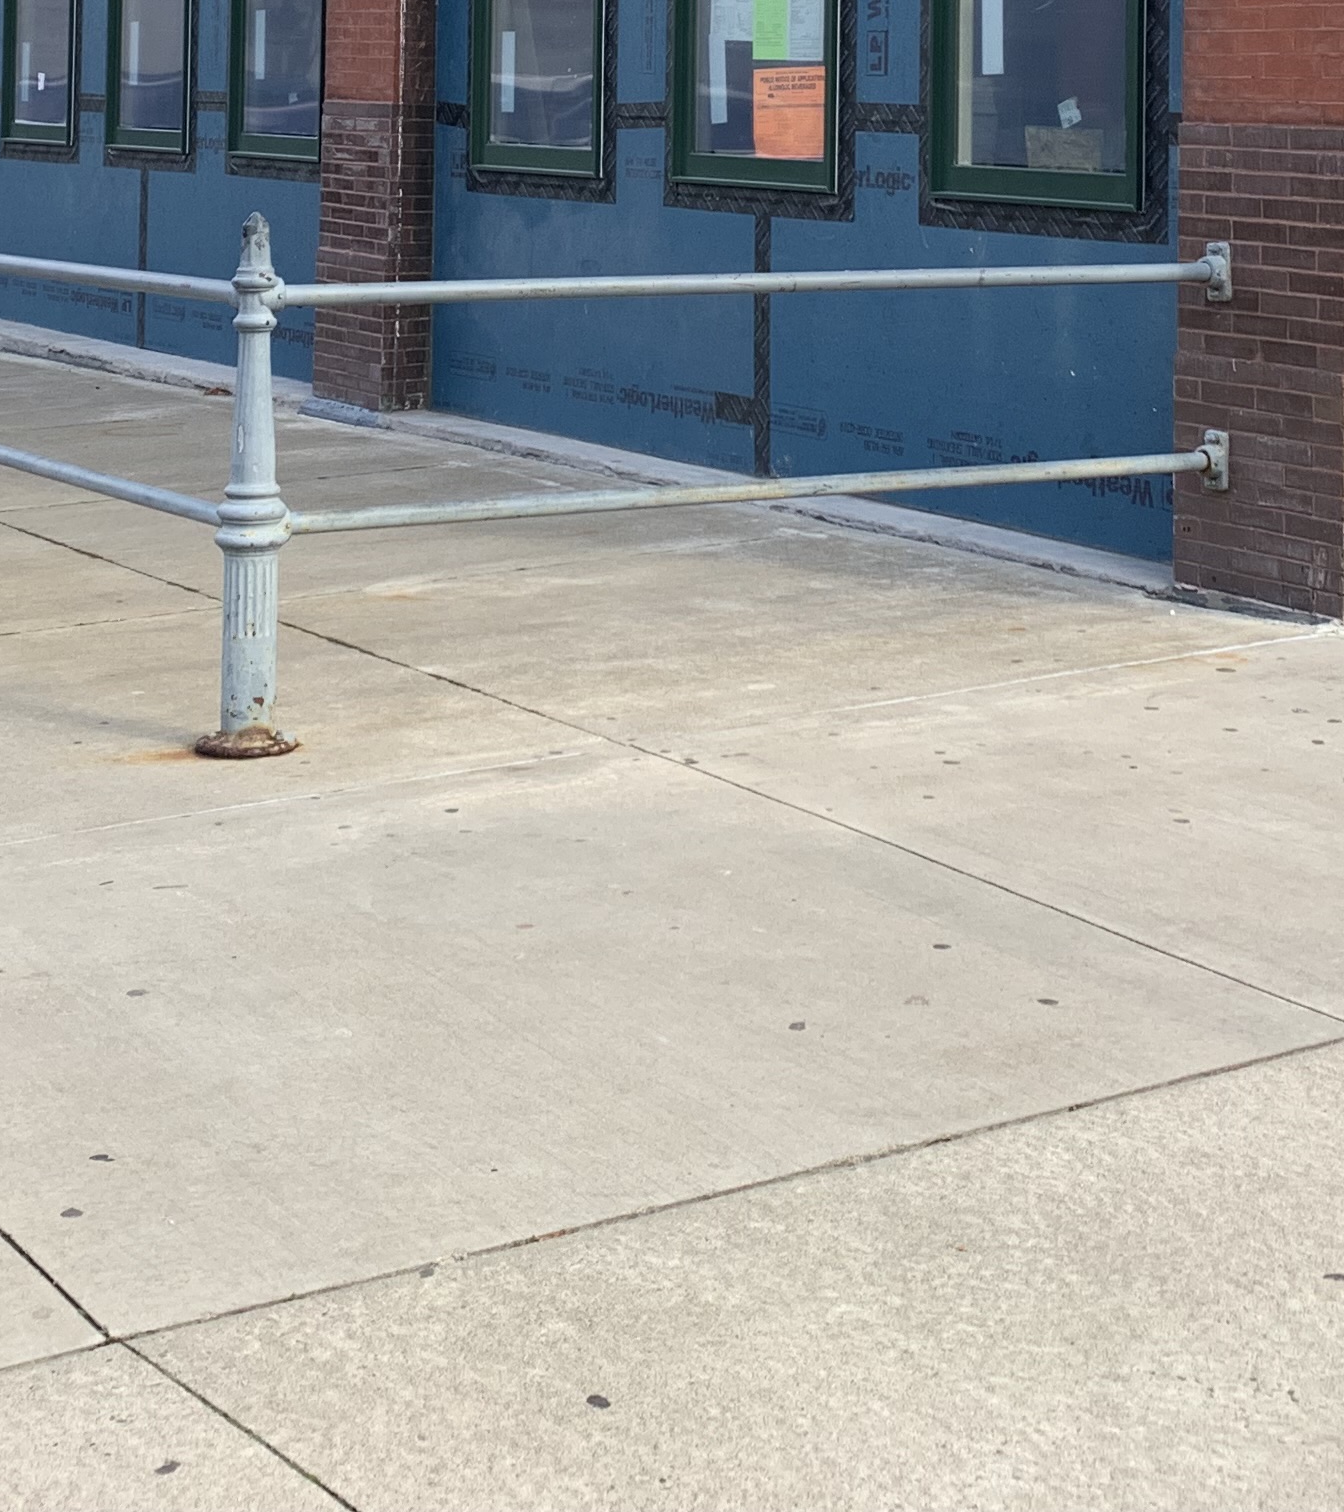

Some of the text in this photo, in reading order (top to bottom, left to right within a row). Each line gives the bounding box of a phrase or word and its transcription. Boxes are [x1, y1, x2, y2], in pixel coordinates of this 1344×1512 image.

[869, 34, 884, 74] LP
[775, 75, 790, 83] NOTICE
[619, 385, 716, 425] WeatherLogic
